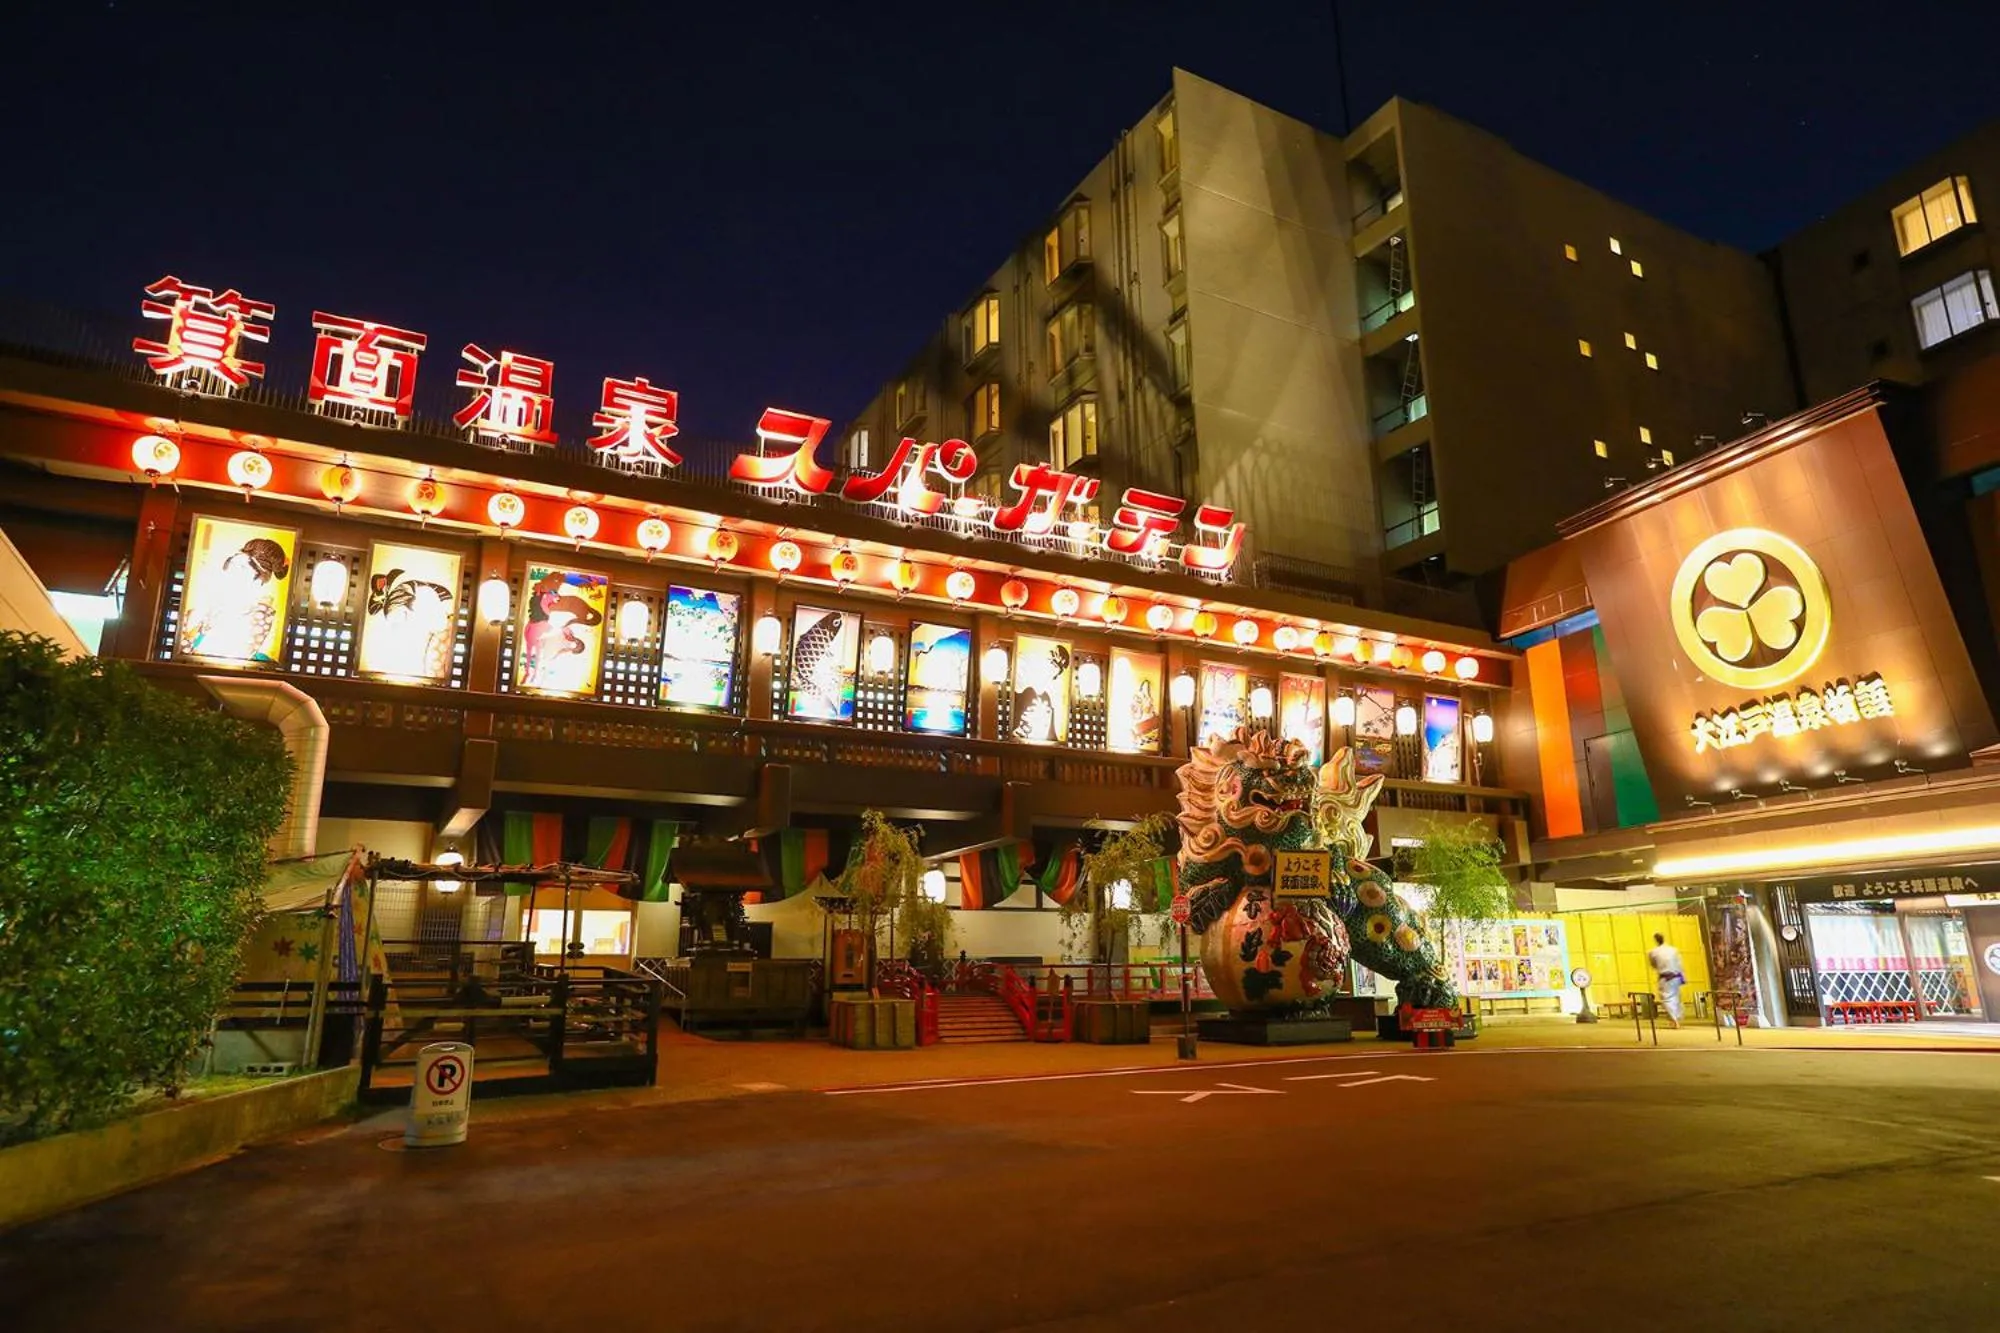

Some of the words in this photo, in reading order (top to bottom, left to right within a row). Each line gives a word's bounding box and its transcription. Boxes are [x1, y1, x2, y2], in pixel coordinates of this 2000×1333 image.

[1691, 675, 1894, 754] 大江戸温泉物語
[1284, 858, 1322, 873] ようこそ
